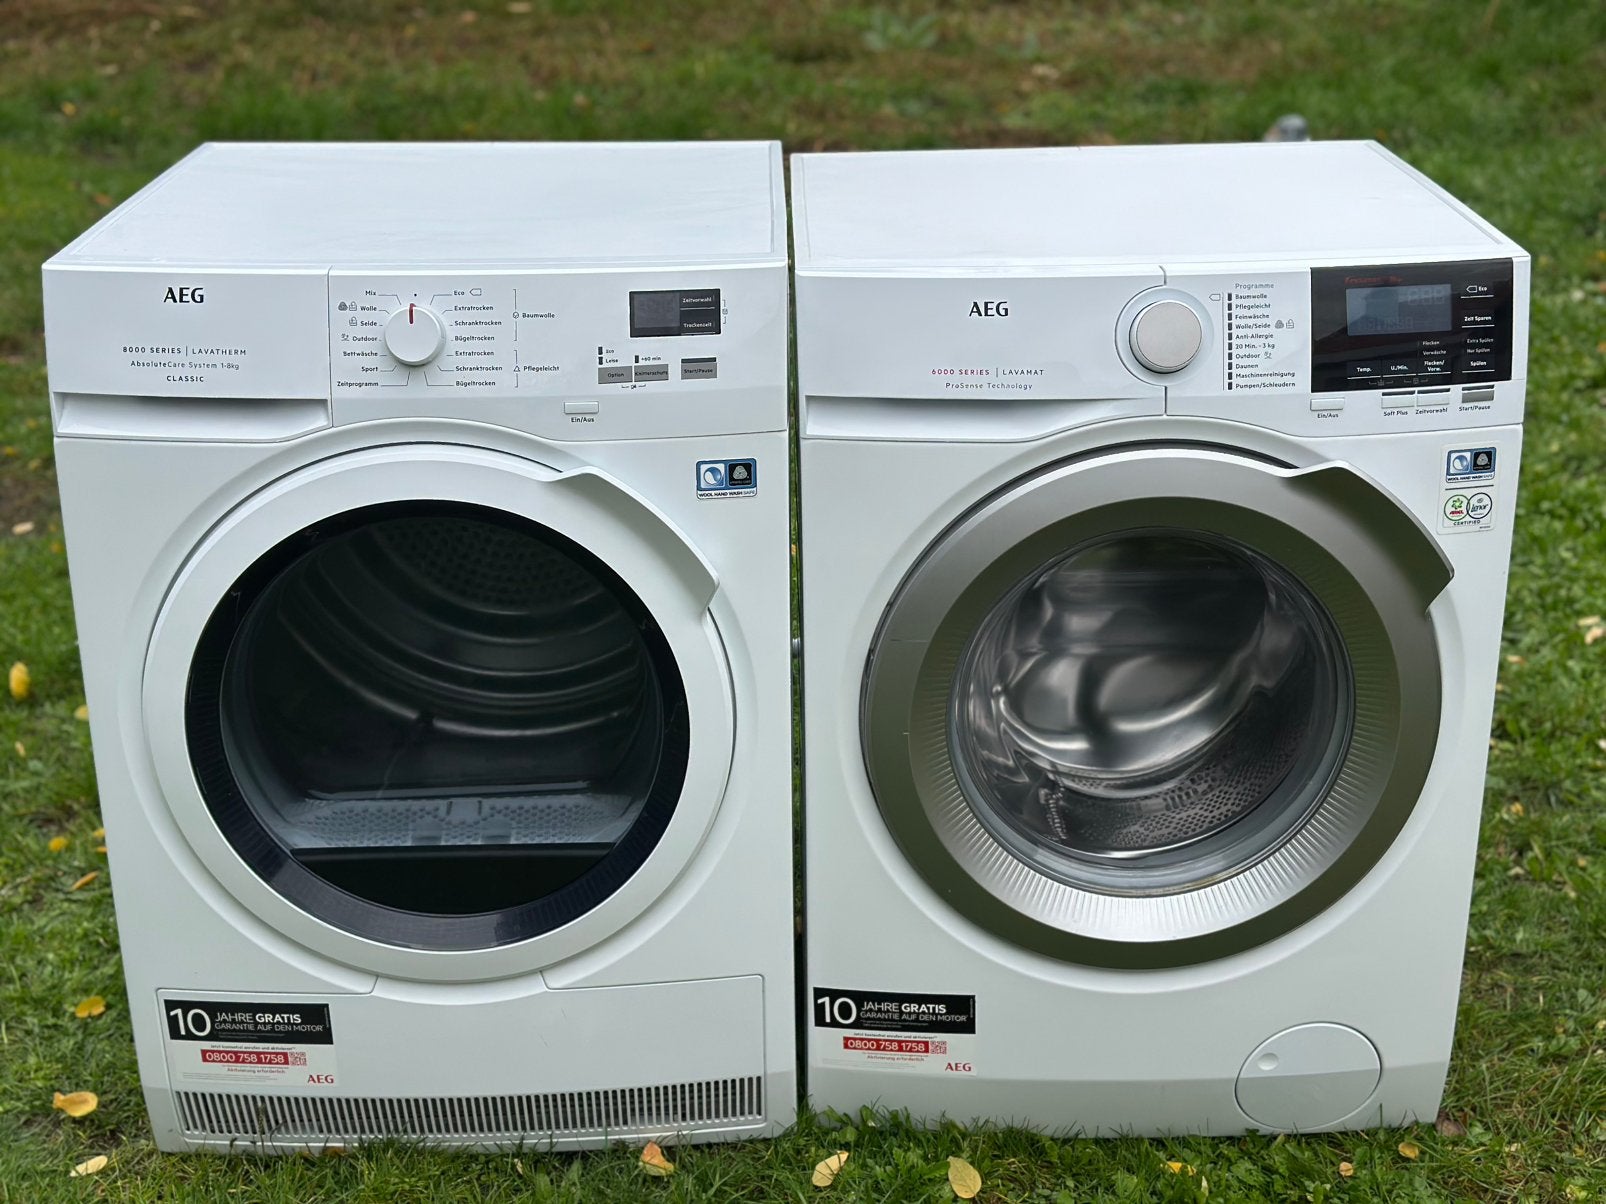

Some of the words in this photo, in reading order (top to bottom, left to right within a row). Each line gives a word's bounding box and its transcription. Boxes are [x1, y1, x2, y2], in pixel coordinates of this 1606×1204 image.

[164, 287, 204, 304] AEG
[968, 301, 1009, 317] AEG
[130, 360, 185, 368] AbsoluteCare
[188, 361, 218, 370] System
[221, 362, 240, 370] 1-8kg
[987, 382, 1033, 390] Technology
[817, 996, 857, 1024] 10
[861, 1001, 899, 1012] JAHRE
[901, 1003, 946, 1014] GRATIS
[214, 1012, 254, 1023] JAHRE
[255, 1013, 302, 1024] GRATIS
[860, 1011, 900, 1020] GARANTIE
[170, 1008, 212, 1037] 10
[214, 1022, 255, 1030] GARANTIE
[848, 1040, 876, 1049] 0800
[879, 1041, 898, 1050] 758
[901, 1043, 925, 1052] 1758
[206, 1052, 236, 1062] 0800
[238, 1053, 258, 1062] 758
[260, 1054, 284, 1064] 1758
[945, 1063, 972, 1072] AEG
[308, 1074, 334, 1084] AEG
